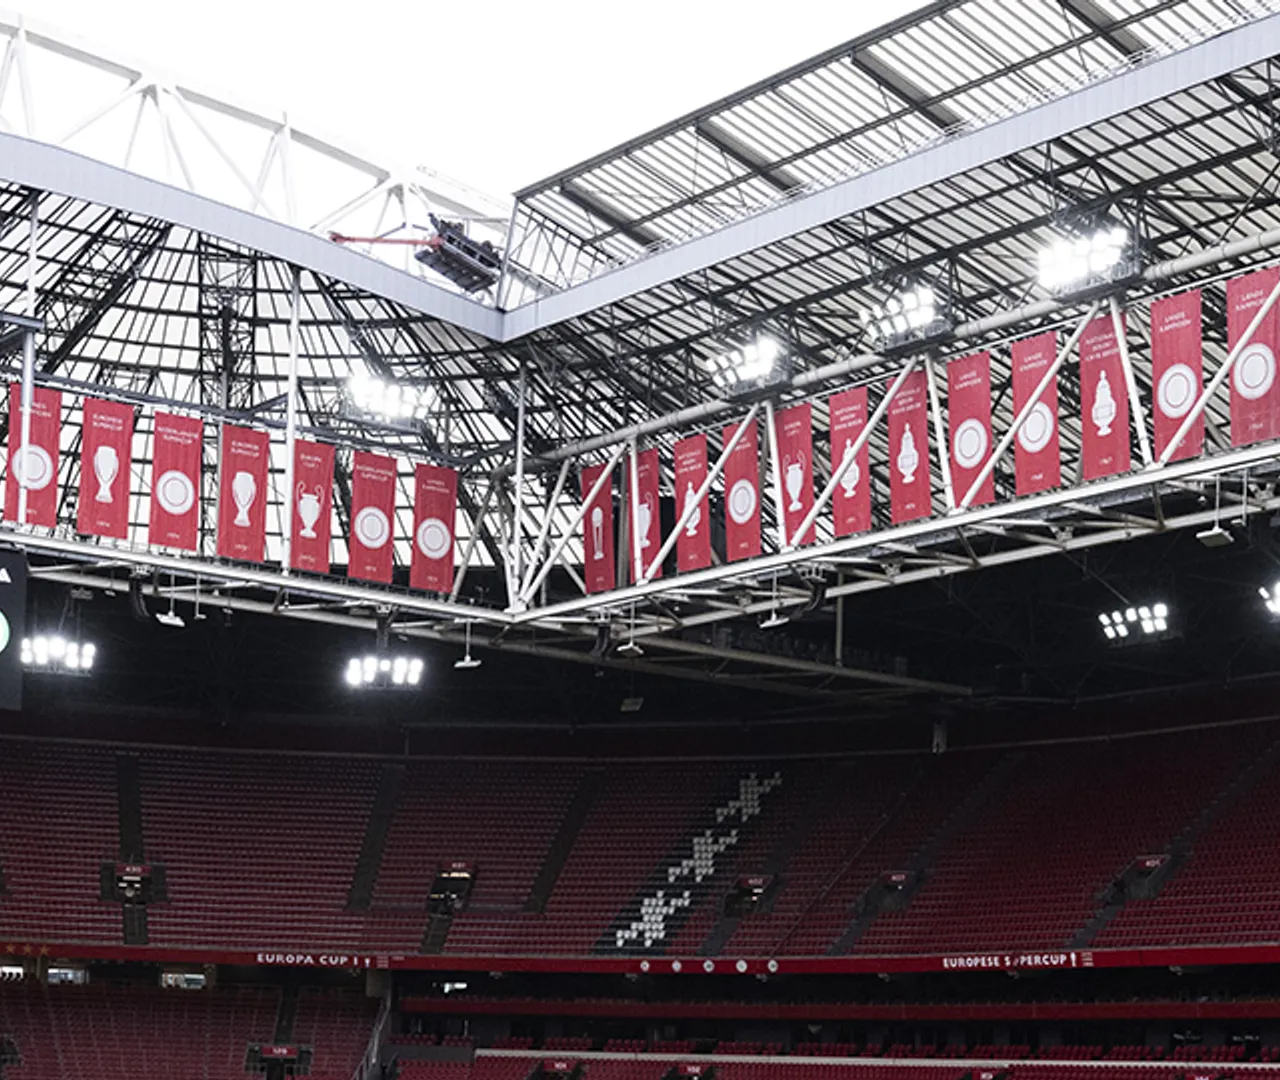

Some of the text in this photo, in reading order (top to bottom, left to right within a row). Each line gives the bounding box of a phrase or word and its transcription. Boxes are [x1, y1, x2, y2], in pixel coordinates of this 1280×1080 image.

[257, 952, 314, 965] EUROPA
[319, 954, 349, 966] CUP
[942, 956, 1000, 969] EUROPESE
